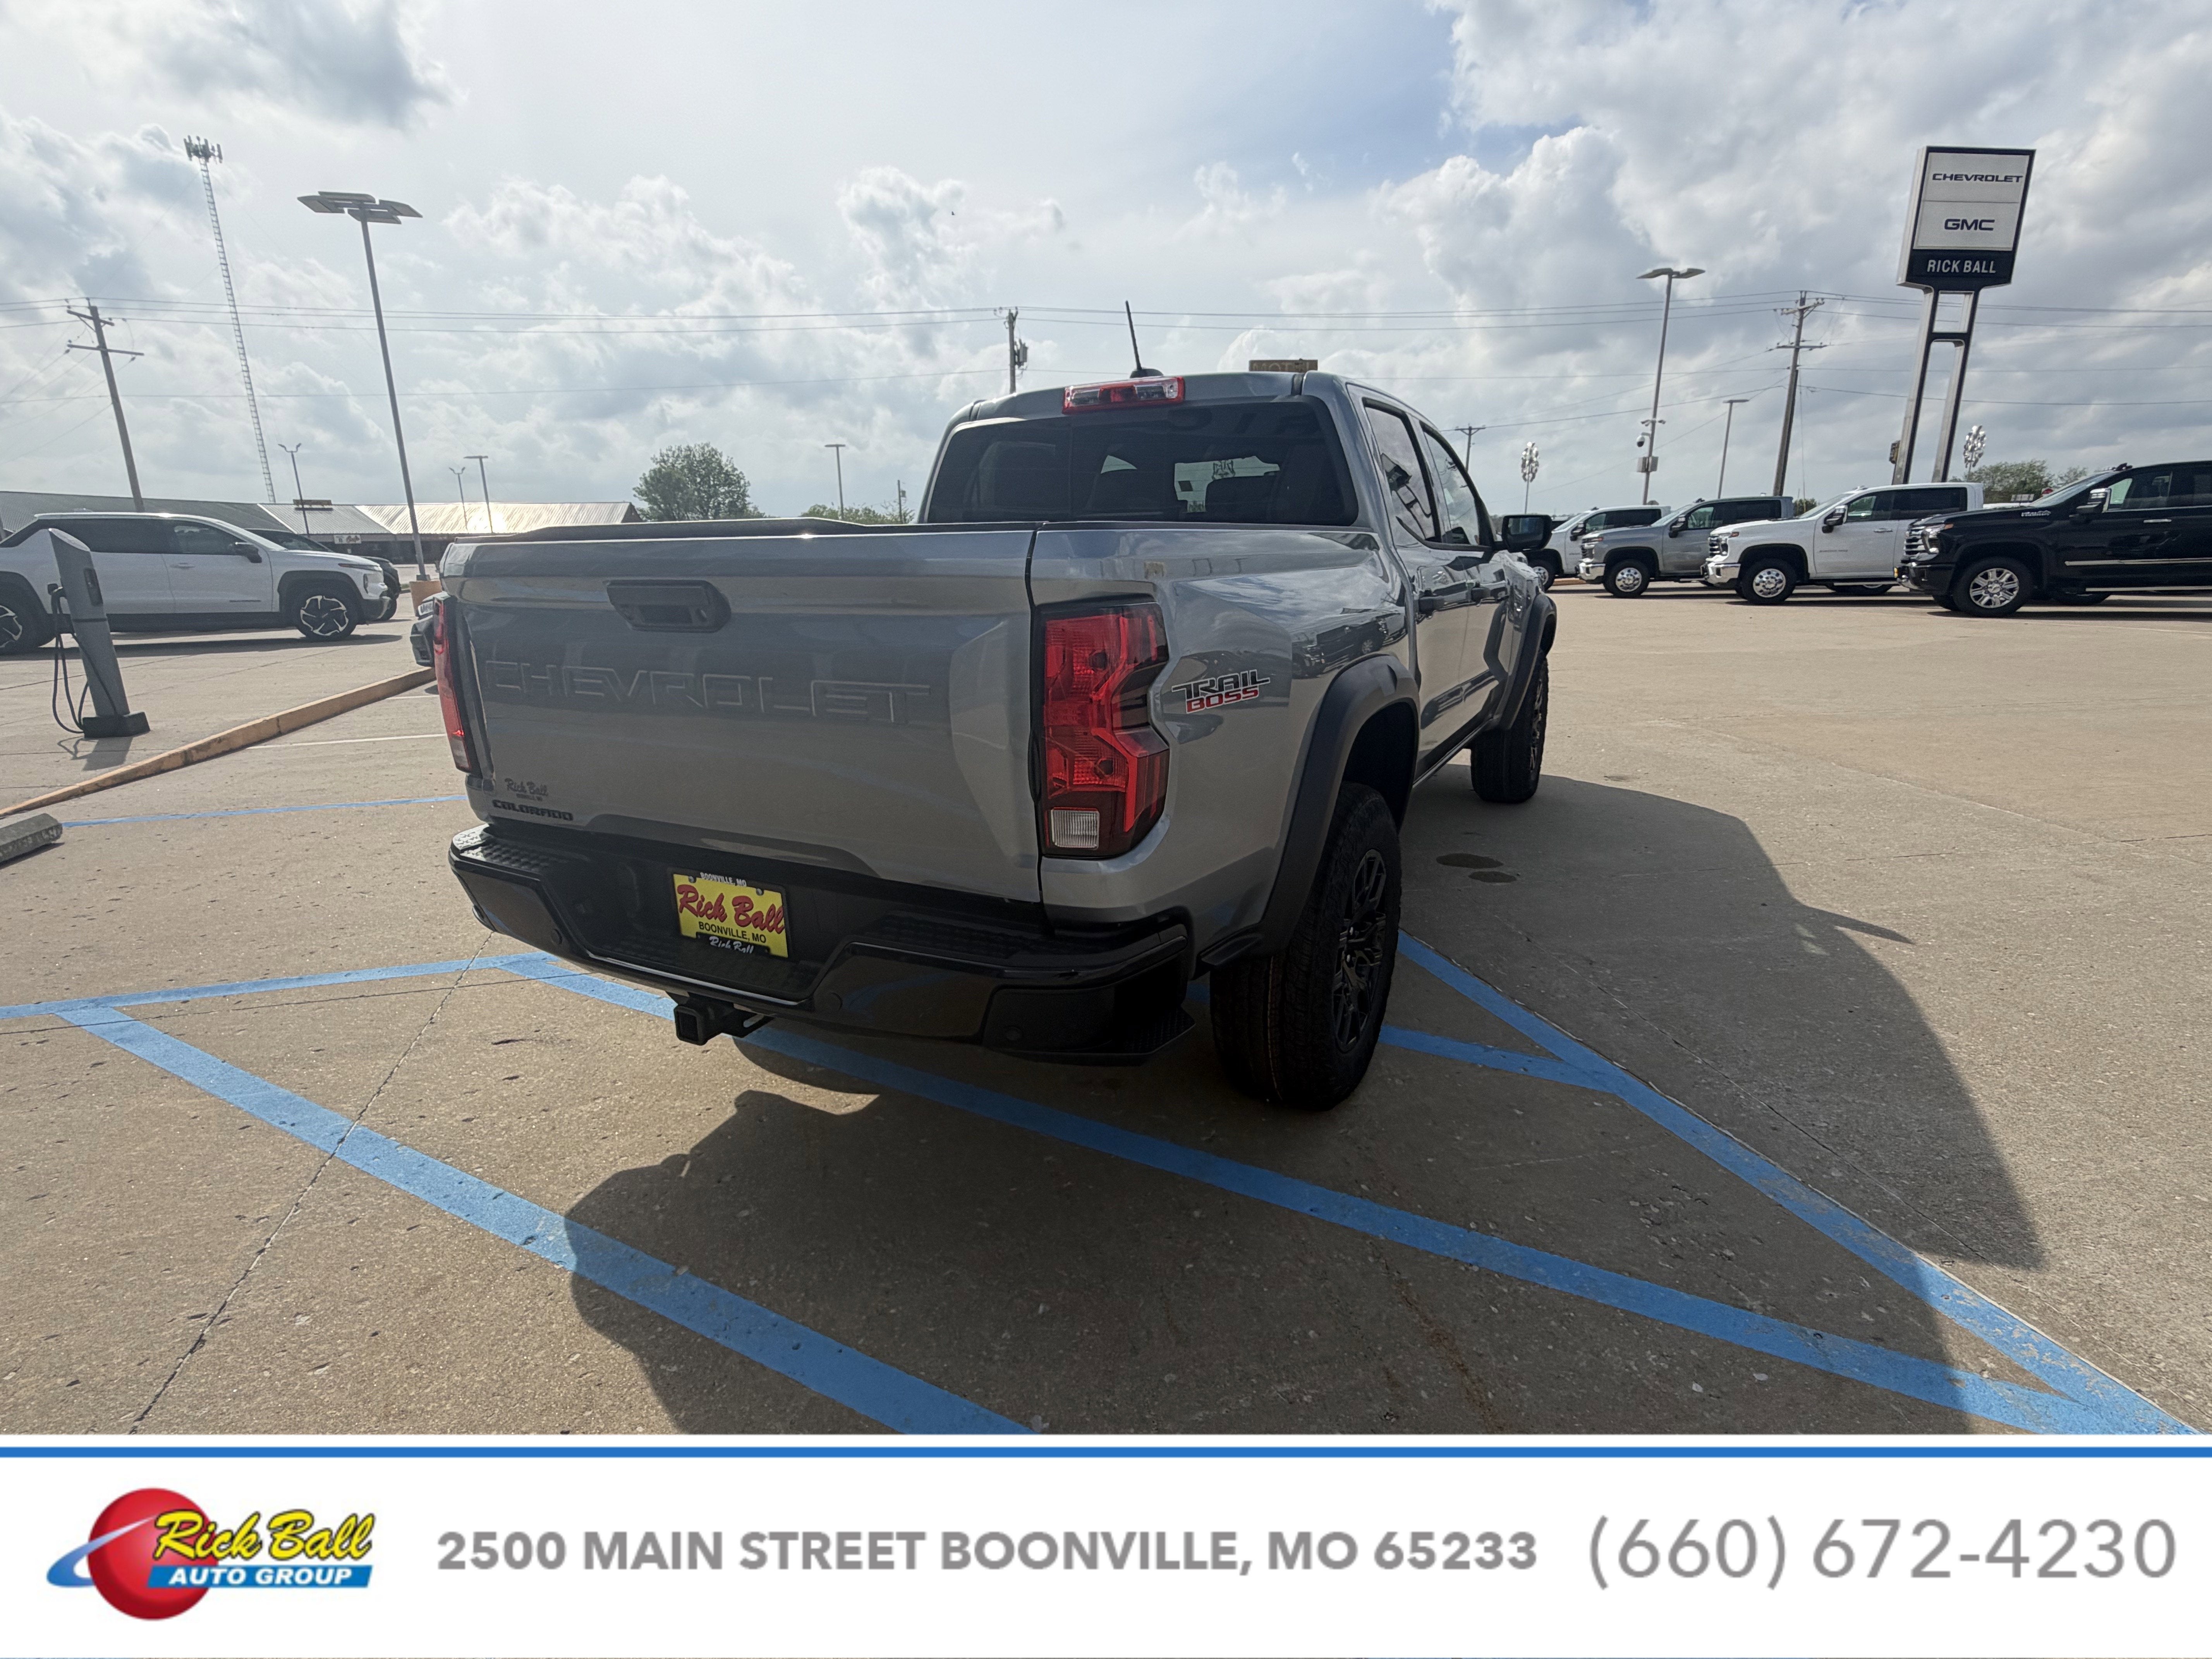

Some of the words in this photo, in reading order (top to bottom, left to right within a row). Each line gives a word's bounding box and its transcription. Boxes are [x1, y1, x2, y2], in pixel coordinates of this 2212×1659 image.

[1932, 173, 2023, 183] CHEVROLET
[1944, 219, 1995, 231] GMC
[1927, 260, 1961, 273] RICK
[1963, 261, 1996, 274] BALL
[486, 661, 930, 723] CHEVROLET
[1171, 669, 1271, 699] TRAIL
[1186, 685, 1259, 714] BOSS
[492, 799, 574, 821] COLORADO
[736, 878, 747, 887] MO
[677, 884, 728, 922] Rick
[732, 895, 785, 934] Ball
[698, 921, 750, 943] BOONVILLE,
[752, 933, 767, 943] MO
